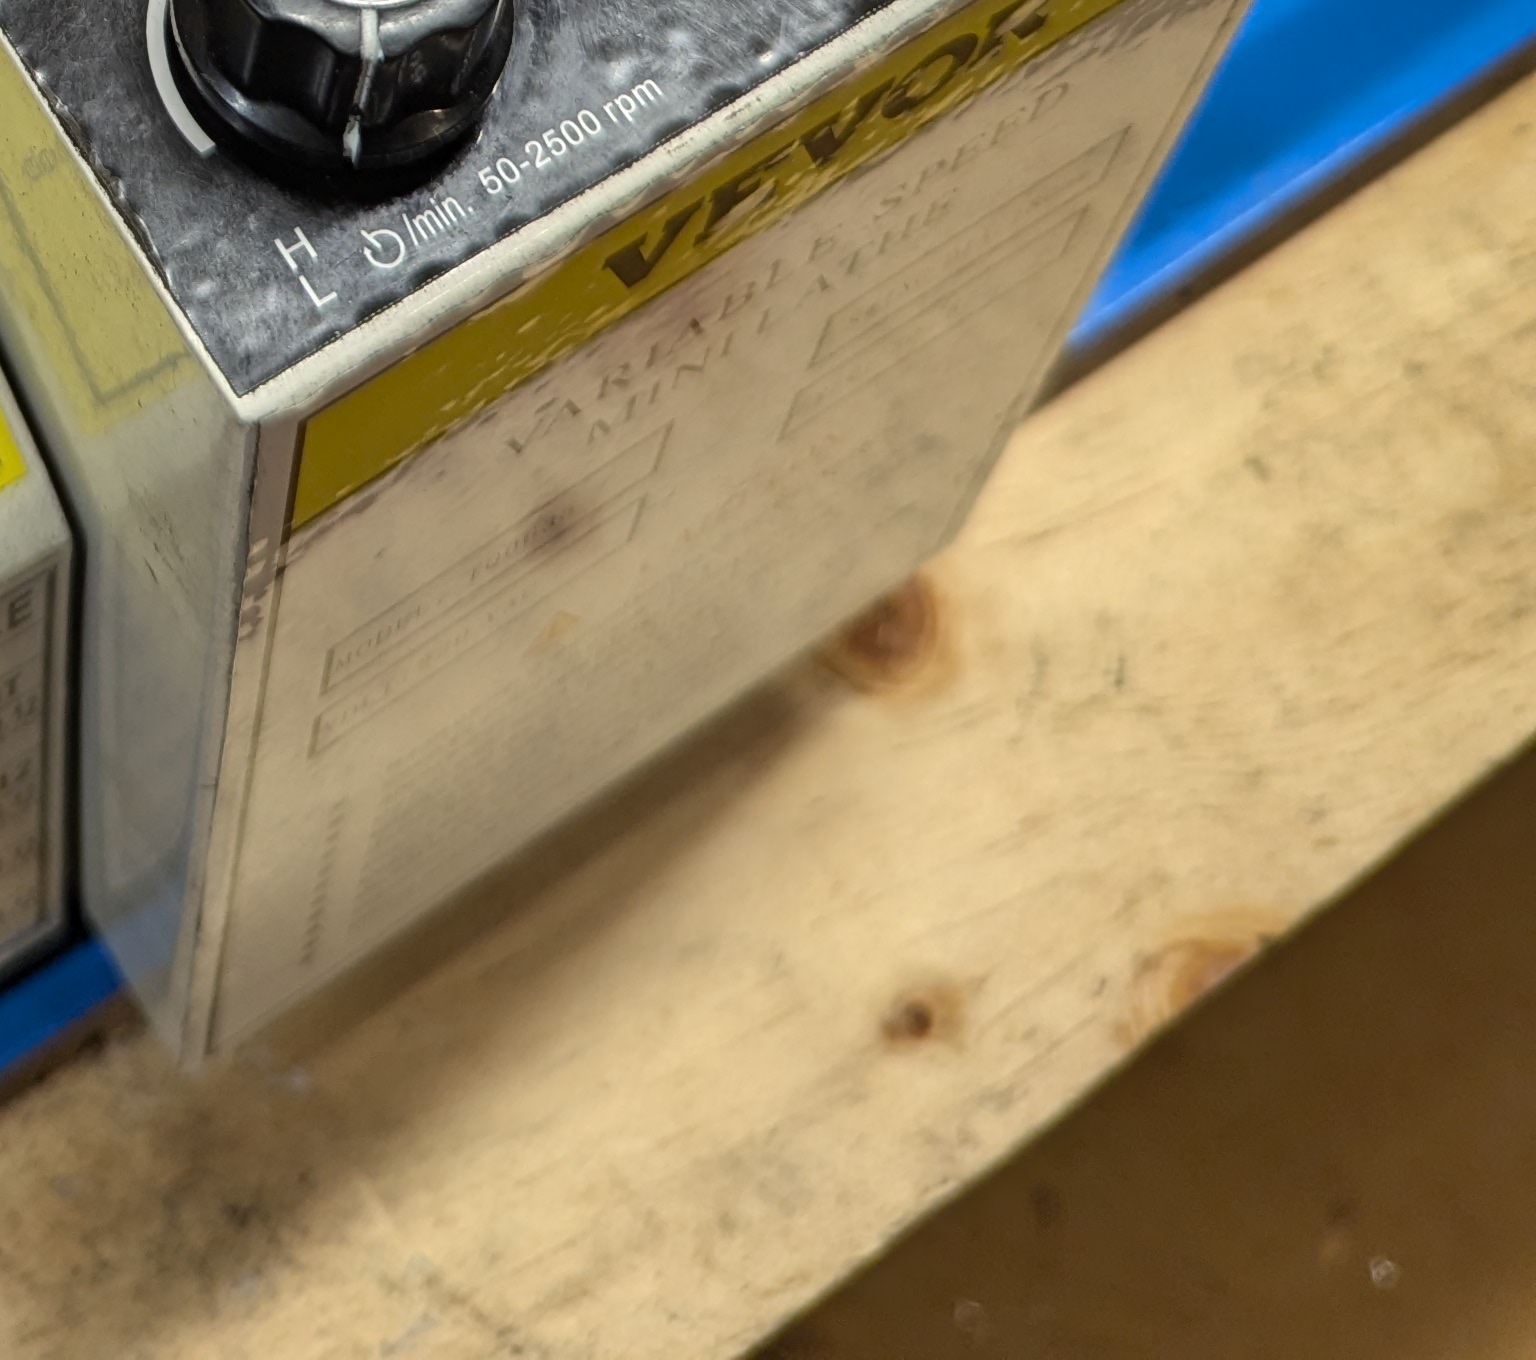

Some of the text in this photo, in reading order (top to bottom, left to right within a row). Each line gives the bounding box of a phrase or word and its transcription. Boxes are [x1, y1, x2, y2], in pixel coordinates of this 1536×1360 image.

[478, 109, 602, 195] 50-2500
[603, 78, 664, 126] rpm
[274, 227, 318, 271] H
[299, 275, 337, 308] L
